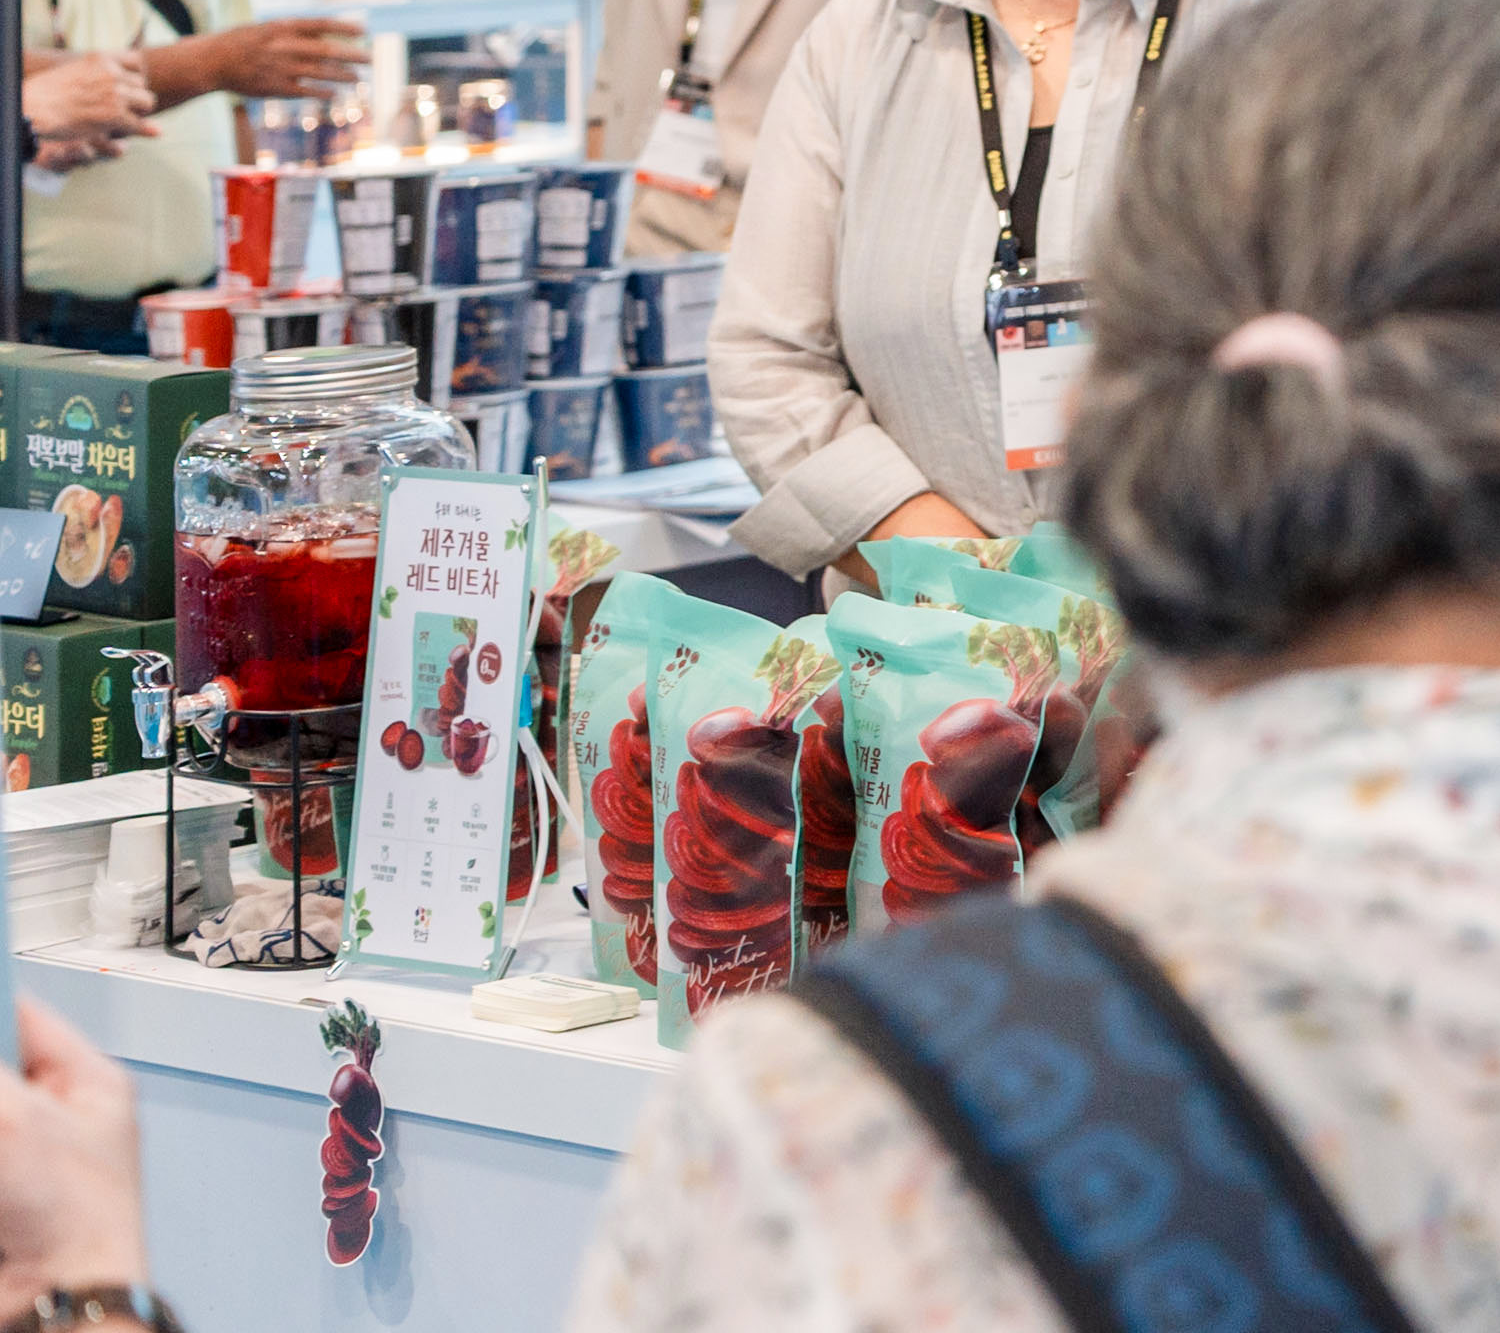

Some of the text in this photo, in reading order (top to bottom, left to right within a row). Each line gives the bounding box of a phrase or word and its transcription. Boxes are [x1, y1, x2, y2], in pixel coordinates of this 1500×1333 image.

[87, 441, 136, 481] 차우더
[420, 528, 491, 562] 제주겨울
[406, 563, 500, 600] 레드 비트차
